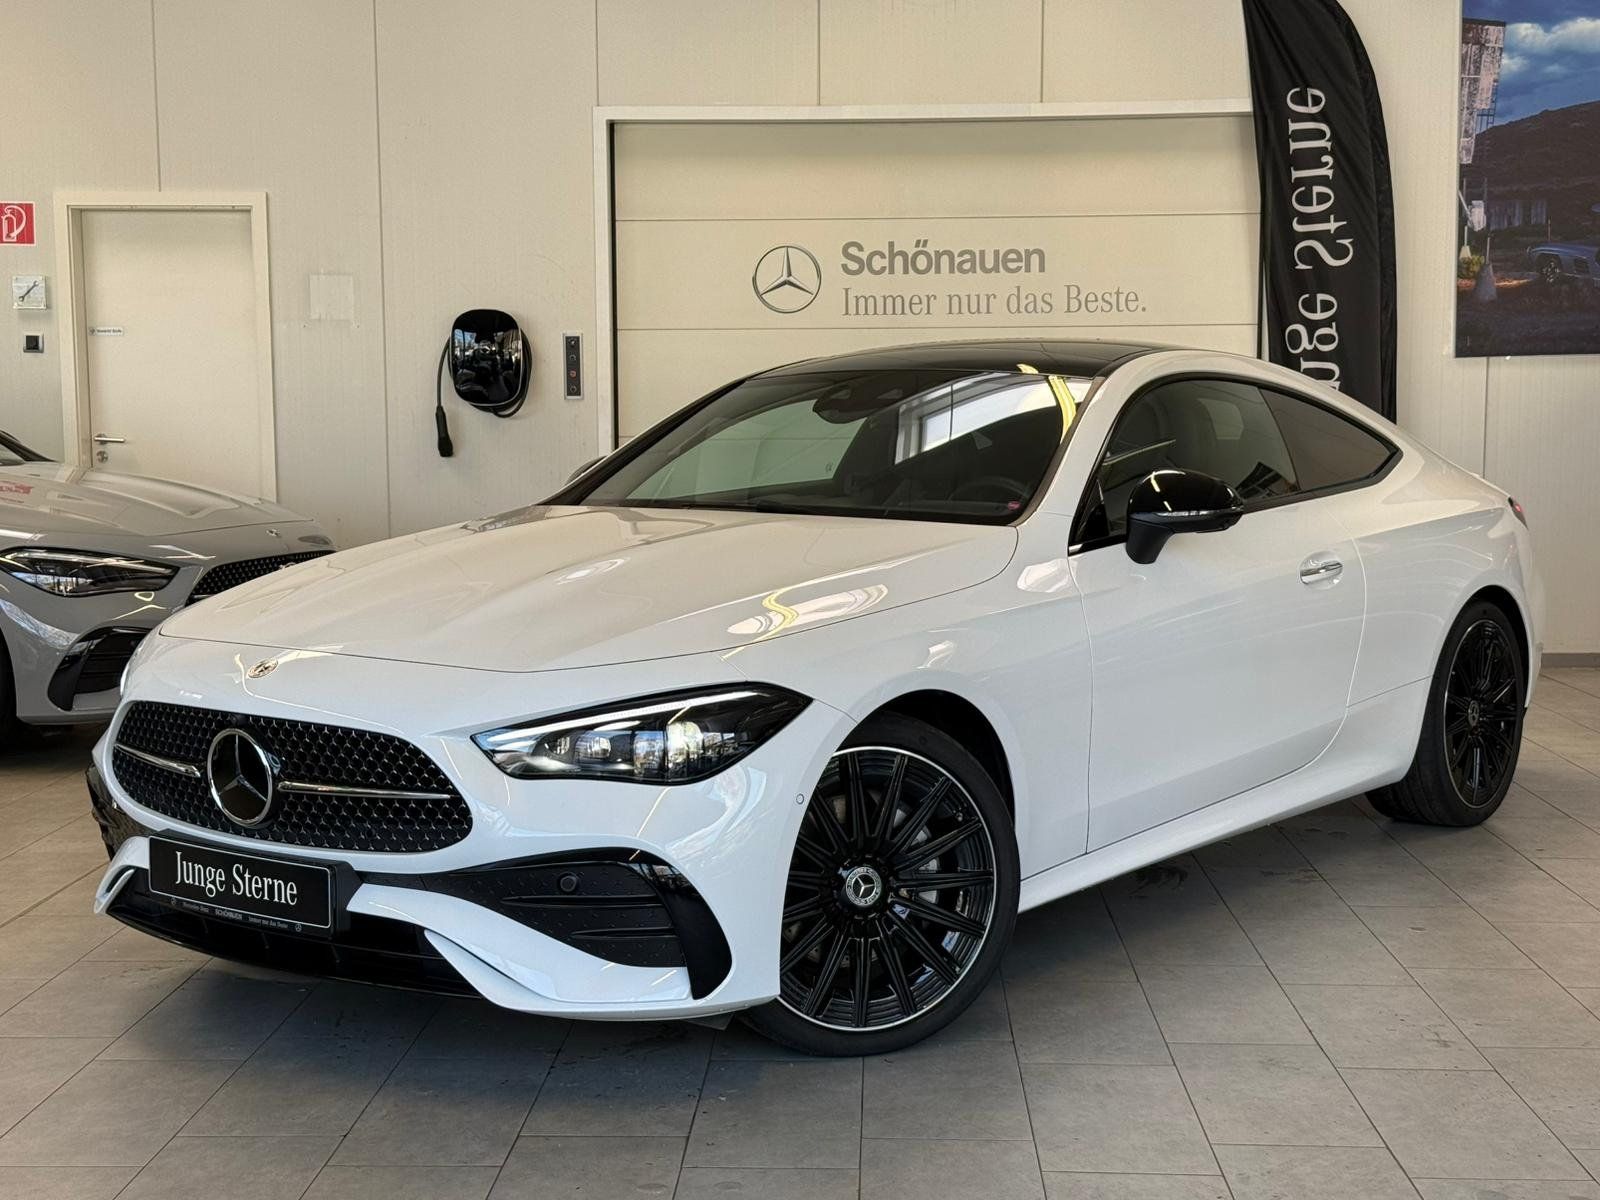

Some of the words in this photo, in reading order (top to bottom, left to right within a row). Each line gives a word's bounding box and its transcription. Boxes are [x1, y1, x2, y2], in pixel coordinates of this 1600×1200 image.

[841, 239, 1046, 275] Schönauen
[842, 287, 937, 316] Immer
[946, 292, 997, 315] nur
[1006, 286, 1053, 314] das
[1064, 284, 1147, 313] Beste.
[175, 851, 226, 897] Junge
[232, 863, 298, 905] Sterne
